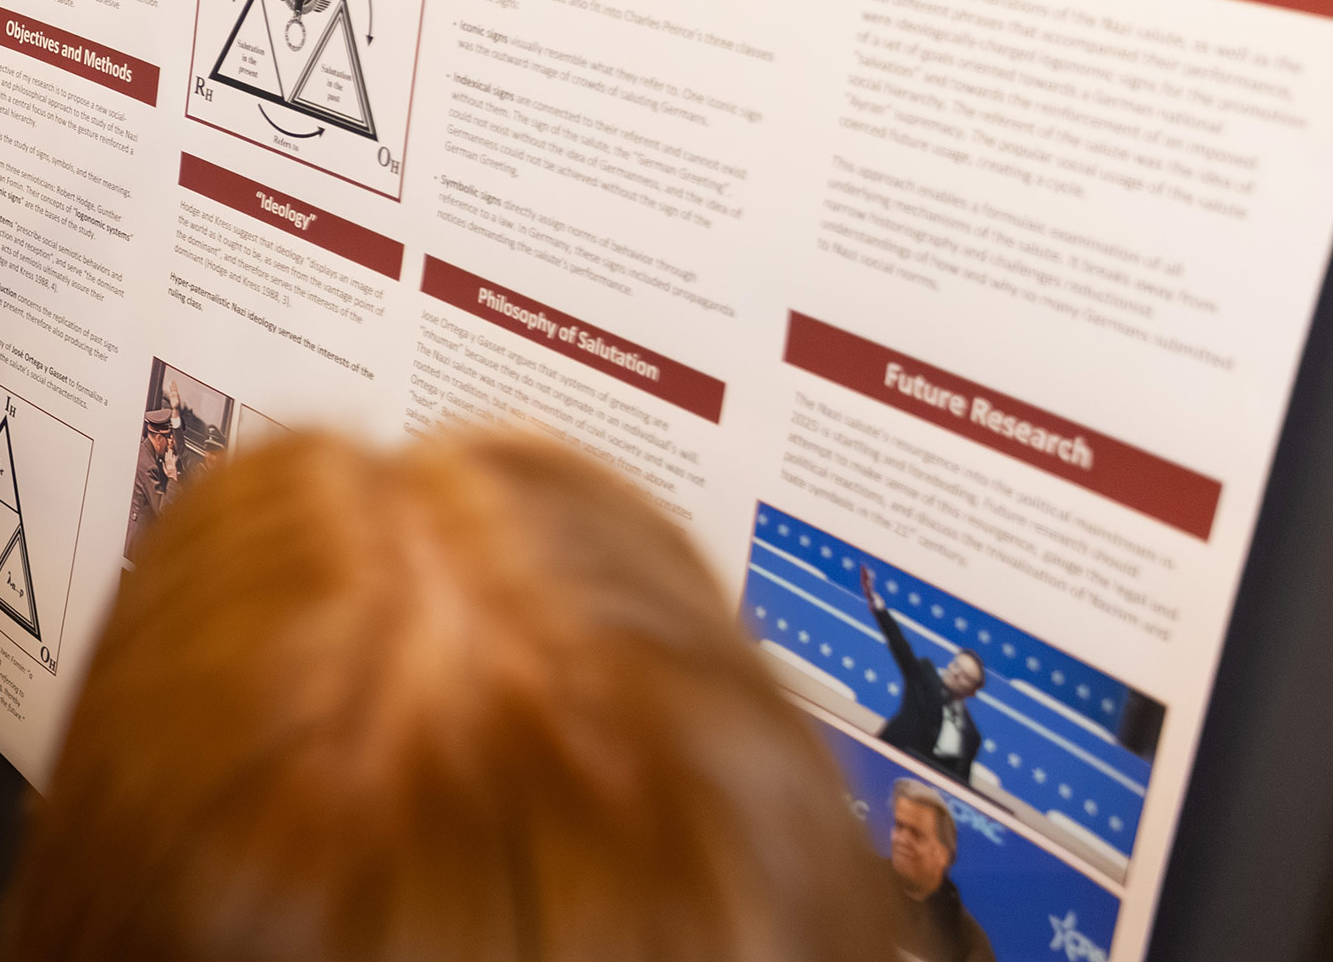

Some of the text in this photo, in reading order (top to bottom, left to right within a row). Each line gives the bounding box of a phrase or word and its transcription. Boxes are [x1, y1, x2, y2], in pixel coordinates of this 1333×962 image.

[5, 19, 133, 84] Objectives and Methods
[14, 139, 29, 153] study
[256, 190, 317, 231] “Ideology”
[168, 287, 186, 304] ruling
[231, 302, 246, 317] Nazi
[247, 309, 278, 334] ideology
[278, 326, 302, 345] served
[303, 337, 315, 352] the
[317, 345, 350, 369] interests
[351, 362, 360, 373] of
[360, 366, 374, 380] the
[478, 287, 660, 382] Philosophy of Salutation
[884, 361, 1095, 472] Future Research
